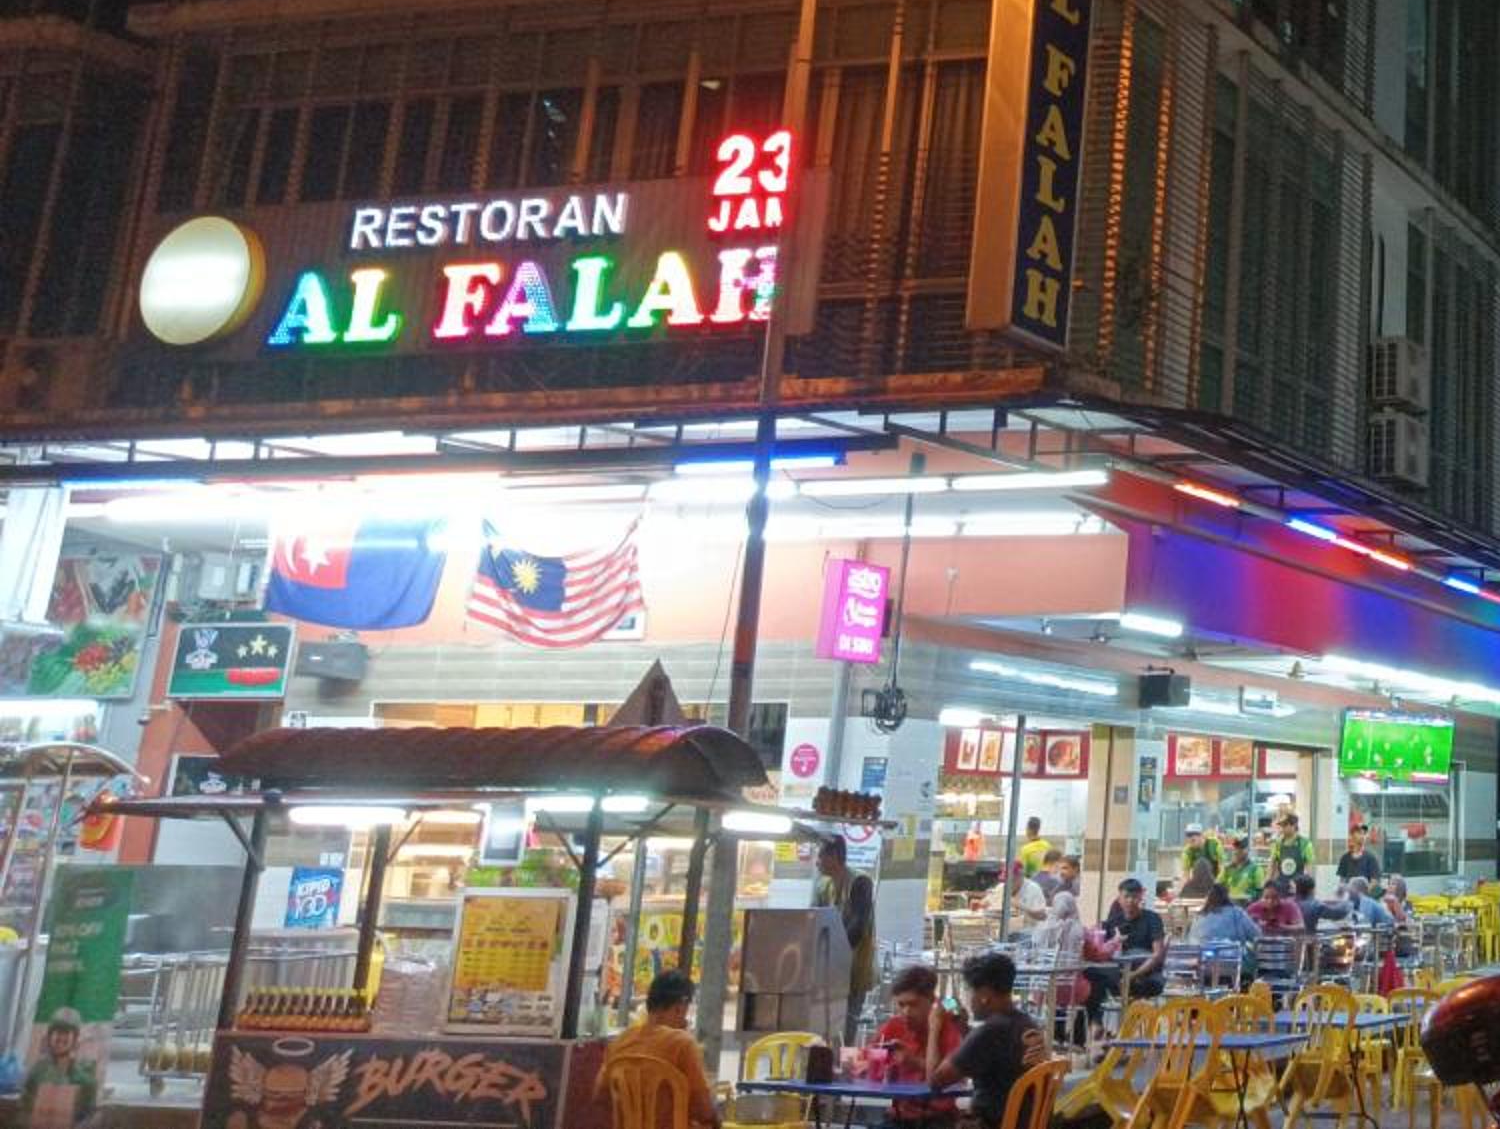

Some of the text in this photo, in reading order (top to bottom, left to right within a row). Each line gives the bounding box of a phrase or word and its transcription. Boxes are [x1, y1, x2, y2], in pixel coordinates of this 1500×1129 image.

[350, 193, 628, 249] RESTORAN
[267, 269, 398, 346] AL
[344, 1046, 547, 1127] BURGER
